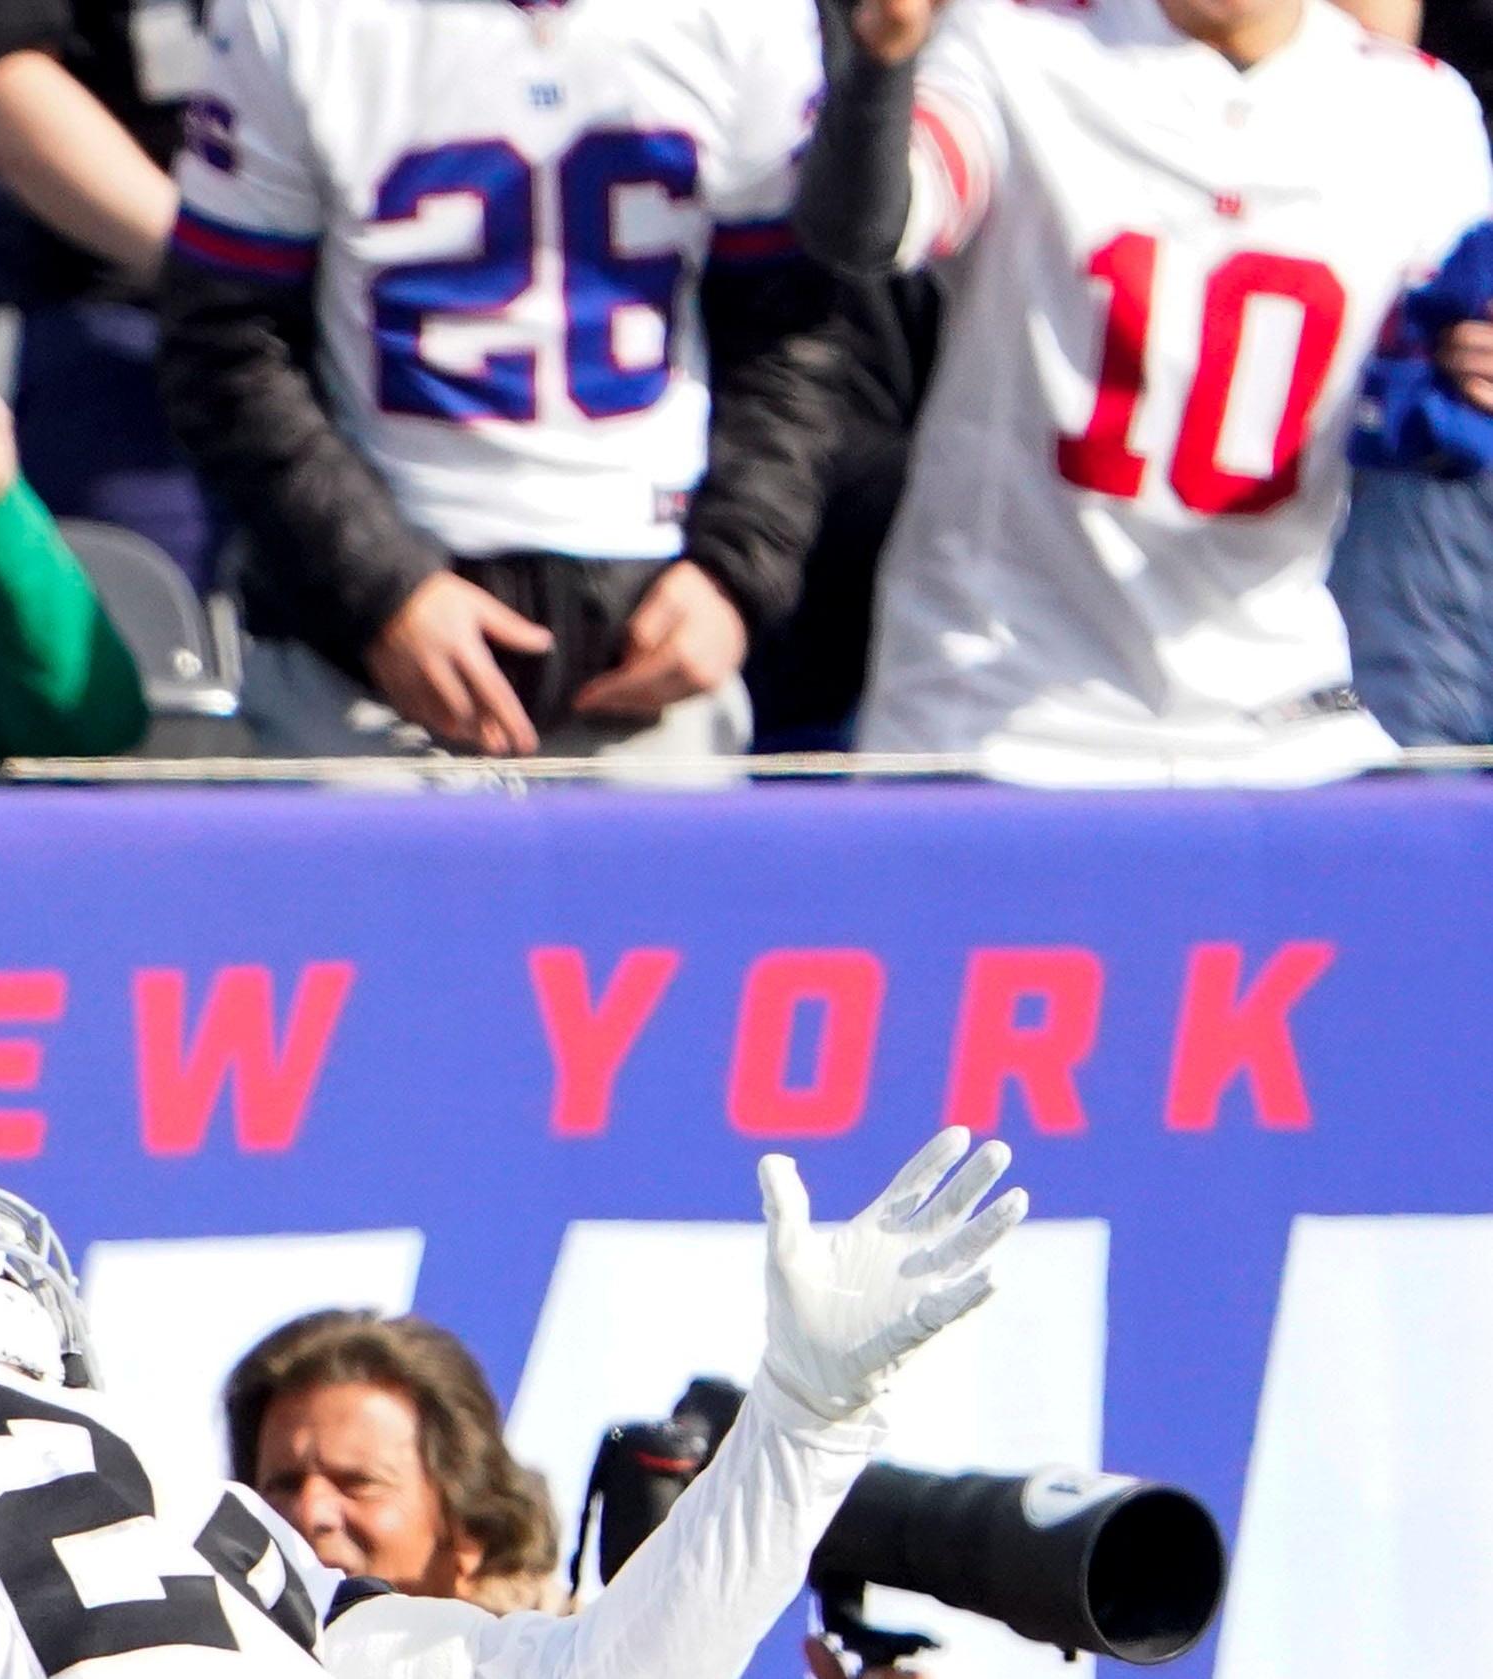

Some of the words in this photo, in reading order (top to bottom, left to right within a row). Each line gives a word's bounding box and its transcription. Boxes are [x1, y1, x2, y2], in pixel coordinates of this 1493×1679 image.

[373, 129, 698, 424] 26
[1055, 231, 1347, 516] 10
[527, 941, 1339, 1138] YORK
